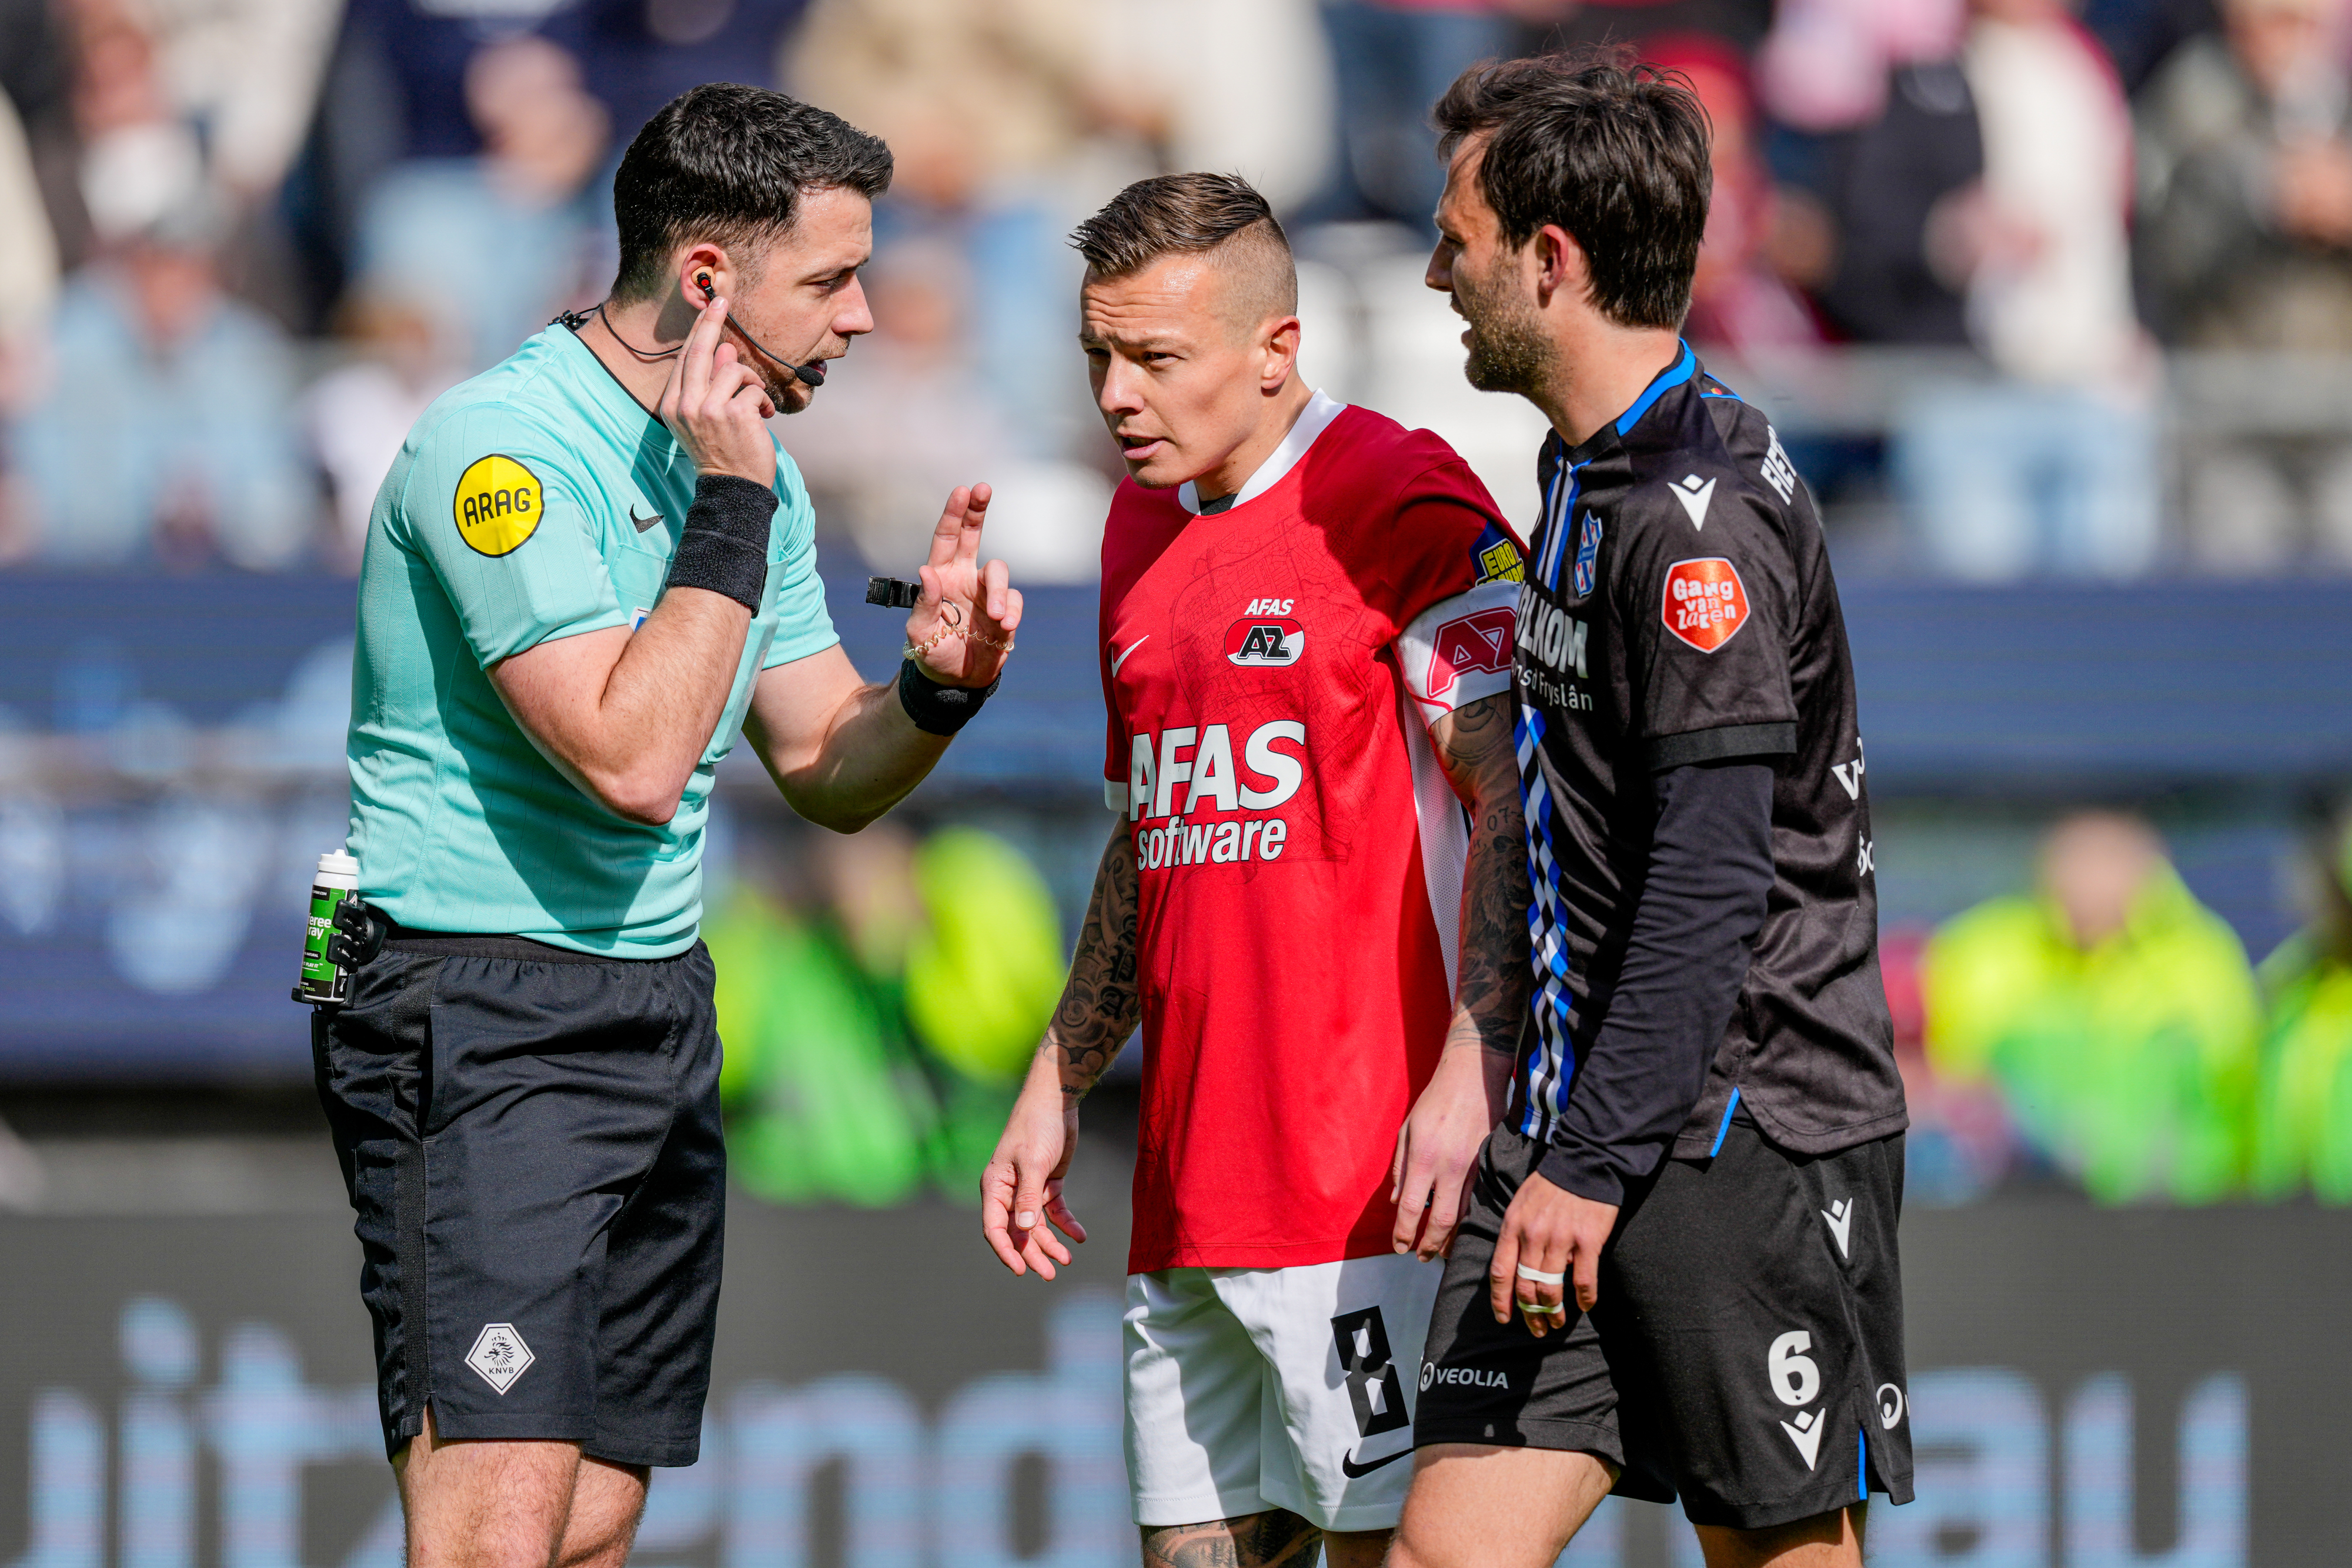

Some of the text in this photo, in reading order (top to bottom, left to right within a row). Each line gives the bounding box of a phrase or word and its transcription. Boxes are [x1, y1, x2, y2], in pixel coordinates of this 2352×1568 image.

[463, 487, 531, 528] ARAG
[1482, 542, 1516, 577] EURO
[1672, 577, 1735, 601] Gang
[1684, 597, 1720, 613] van
[1244, 599, 1294, 616] AFAS
[1237, 626, 1292, 660] AZ
[1514, 579, 1589, 678] OLKOM
[1539, 670, 1593, 711] Fryslân
[1130, 720, 1305, 821] AFAS
[1138, 815, 1287, 871] software
[307, 926, 324, 940] ray
[309, 912, 332, 928] feree
[1331, 1305, 1410, 1438] 8
[1436, 1368, 1509, 1389] VEOLIA
[1768, 1330, 1820, 1406] 6
